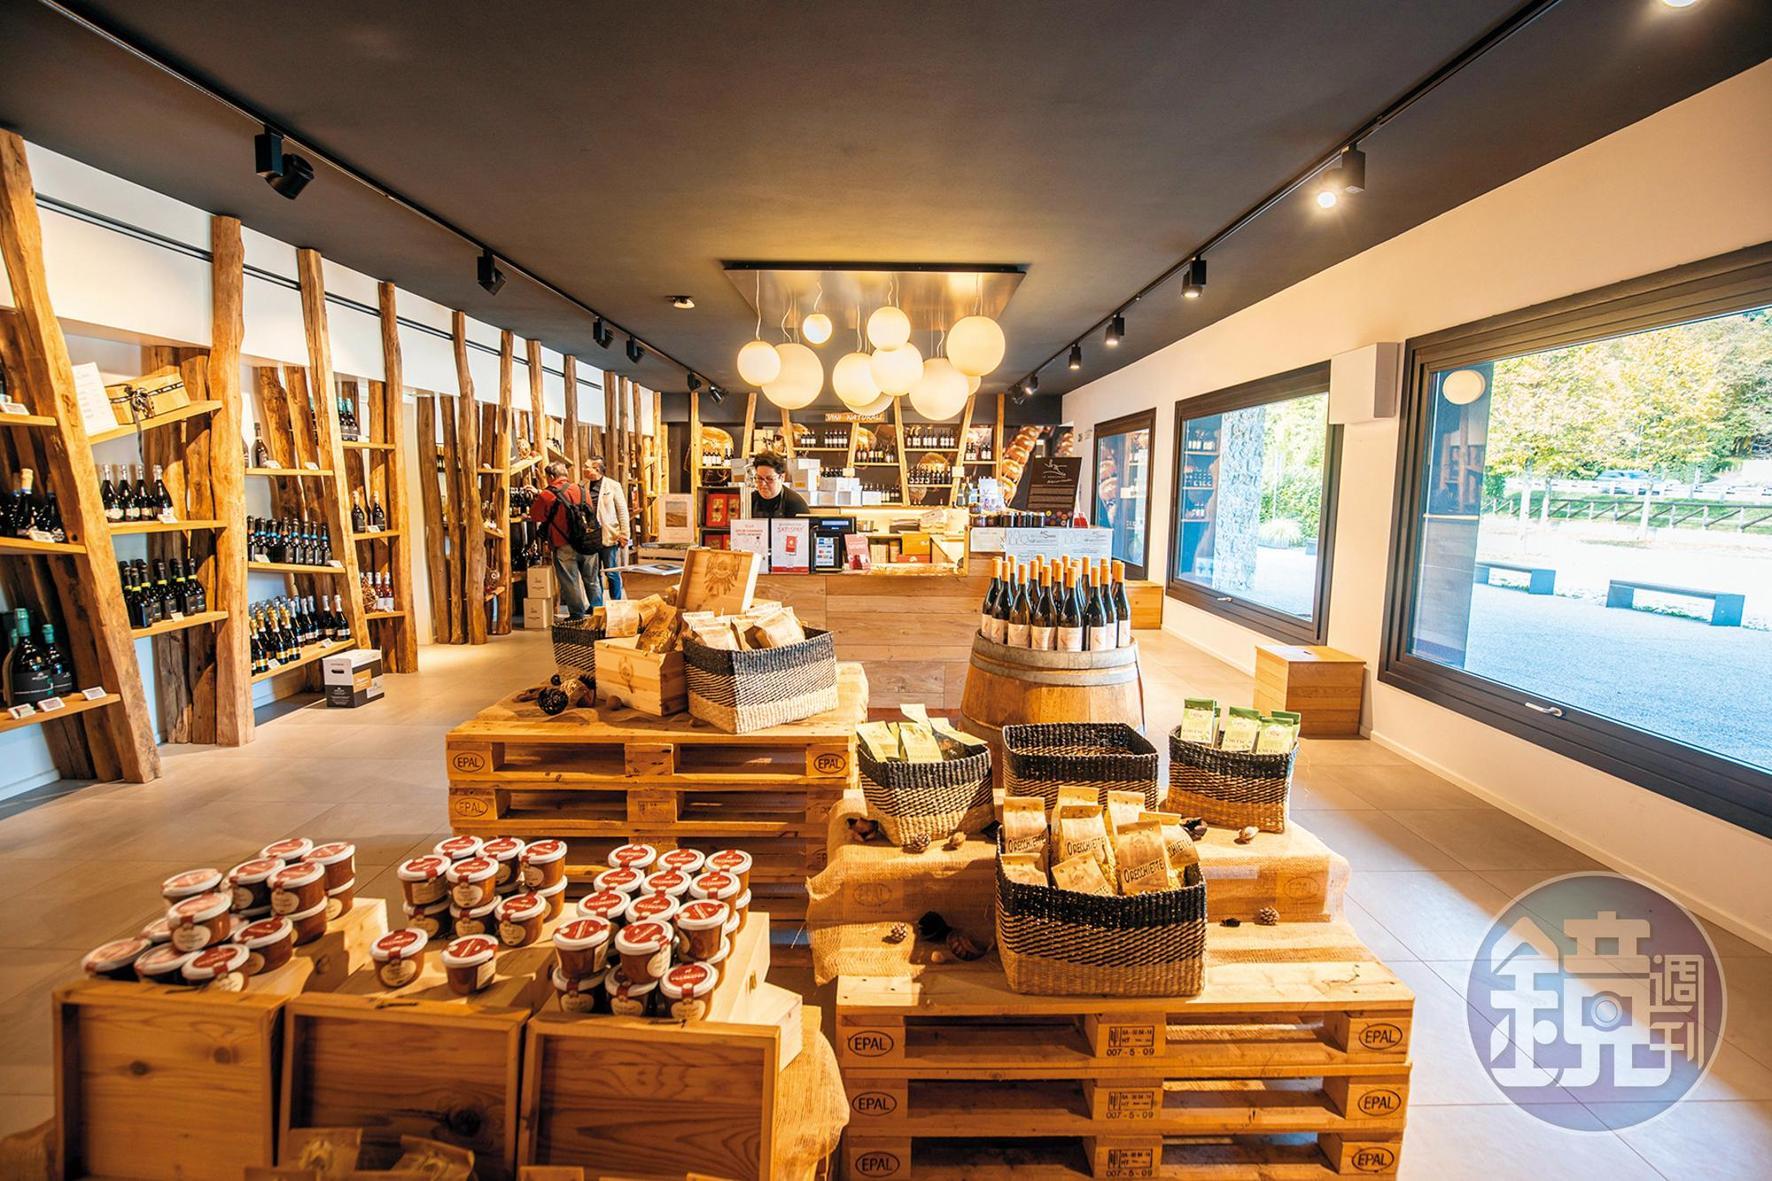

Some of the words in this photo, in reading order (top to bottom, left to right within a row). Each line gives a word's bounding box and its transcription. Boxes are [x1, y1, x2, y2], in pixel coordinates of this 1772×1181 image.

[457, 757, 480, 768] EPAL
[818, 758, 840, 769] EPAL
[458, 802, 483, 813] EPAL
[1123, 859, 1165, 883] ORECCHIETTE
[1365, 1030, 1395, 1044] EPAL
[854, 1037, 886, 1051] EPAL
[858, 1098, 889, 1110] EPAL
[1363, 1096, 1394, 1110] EPAL
[861, 1158, 892, 1171] EPAL
[1357, 1154, 1387, 1166] EPAL
